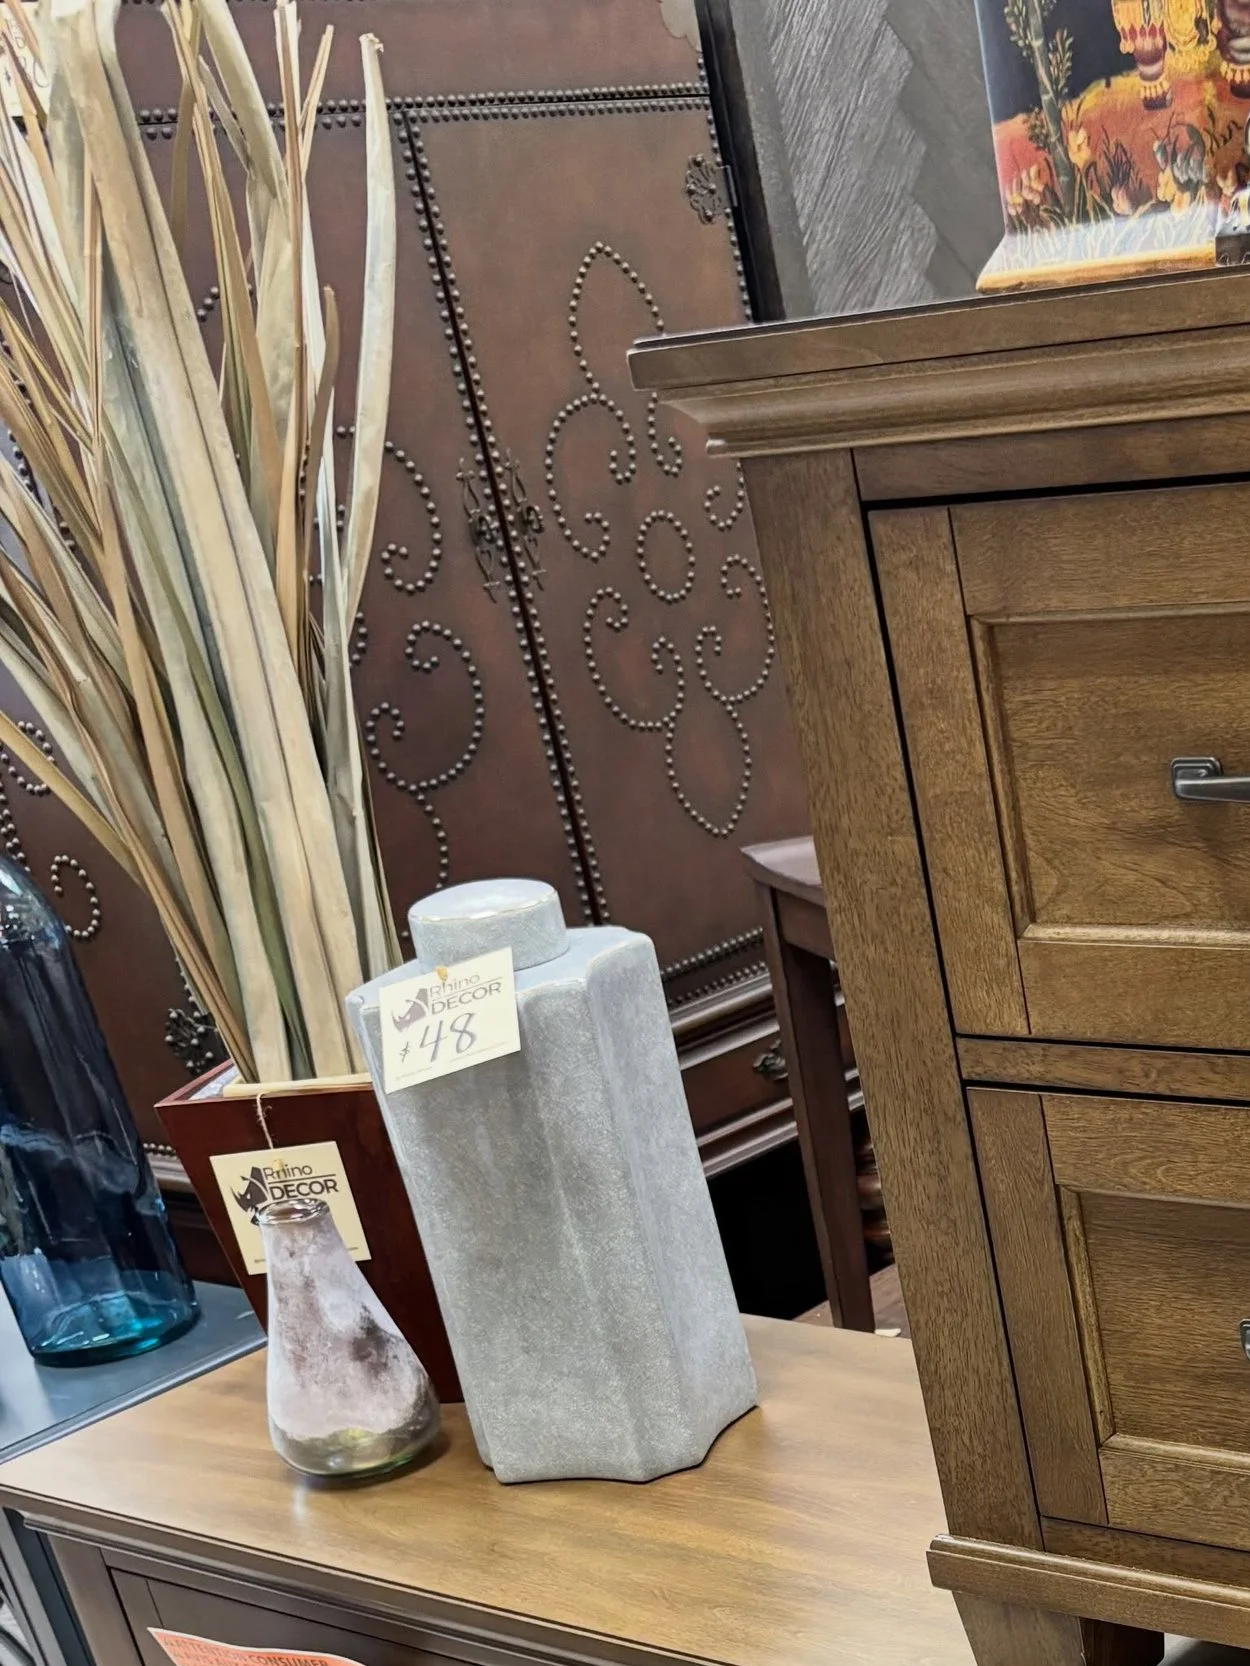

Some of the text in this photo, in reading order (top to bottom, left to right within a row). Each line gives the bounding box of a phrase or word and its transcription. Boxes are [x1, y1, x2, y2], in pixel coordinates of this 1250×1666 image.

[429, 974, 481, 997] Rhino
[431, 981, 502, 1015] DECOR
[269, 1179, 339, 1201] DECOR
